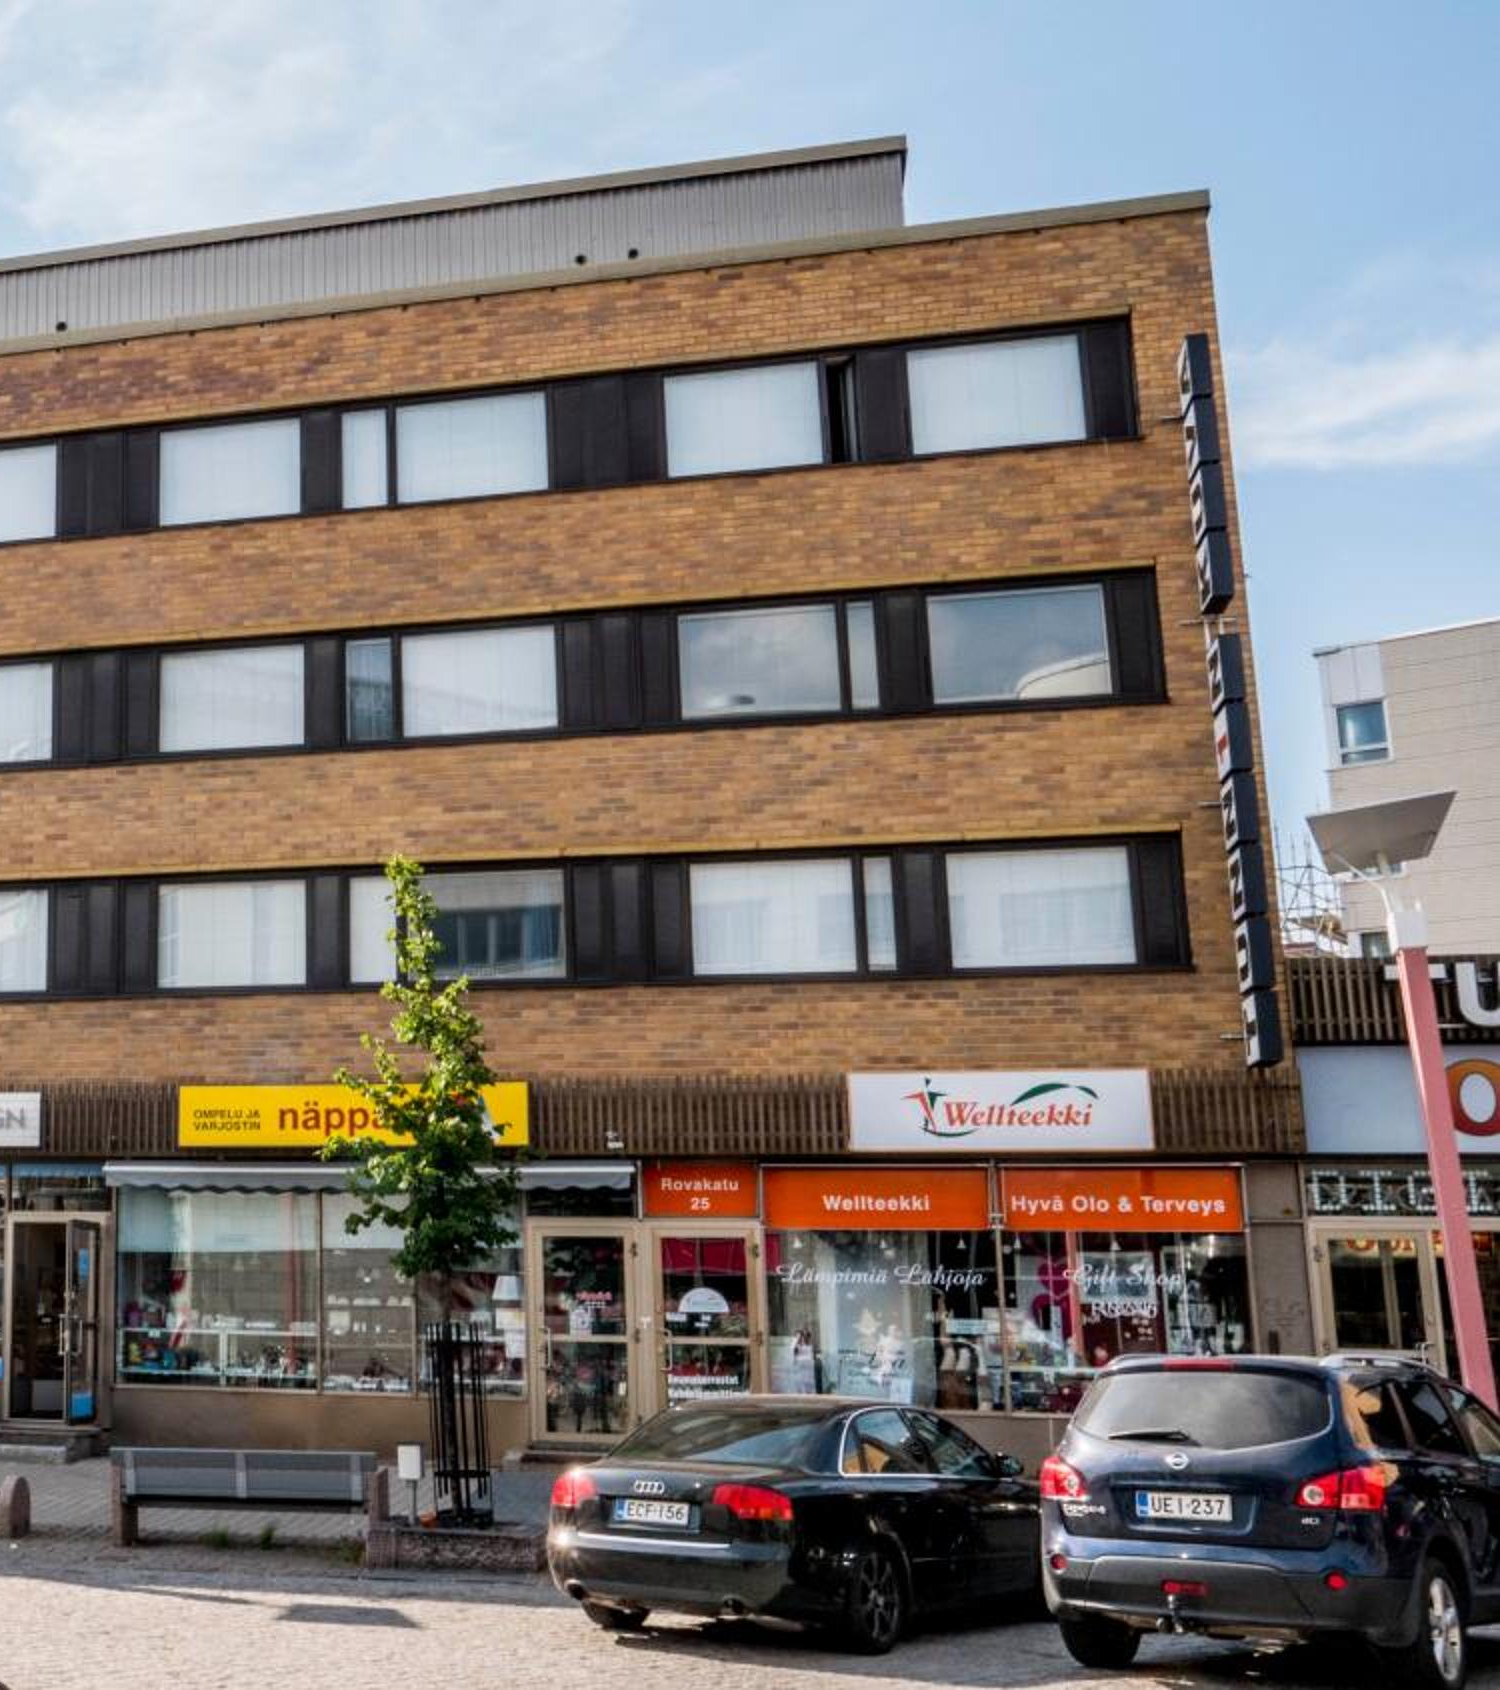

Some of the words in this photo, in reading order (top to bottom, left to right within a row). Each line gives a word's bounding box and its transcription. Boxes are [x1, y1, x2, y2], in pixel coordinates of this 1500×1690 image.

[944, 1101, 1093, 1127] Wellteekki
[660, 1177, 740, 1191] Rovakatu
[690, 1197, 710, 1210] 25
[823, 1195, 930, 1211] Wellteekki
[1011, 1195, 1063, 1212] Hyvä
[1071, 1195, 1109, 1212] Olo
[1118, 1196, 1132, 1212] &
[1141, 1195, 1226, 1215] Terveys
[775, 1263, 889, 1285] Lämpimiä
[893, 1263, 988, 1291] Lahjoja
[627, 1501, 685, 1521] ECF-156
[1151, 1496, 1227, 1518] UEI-237
